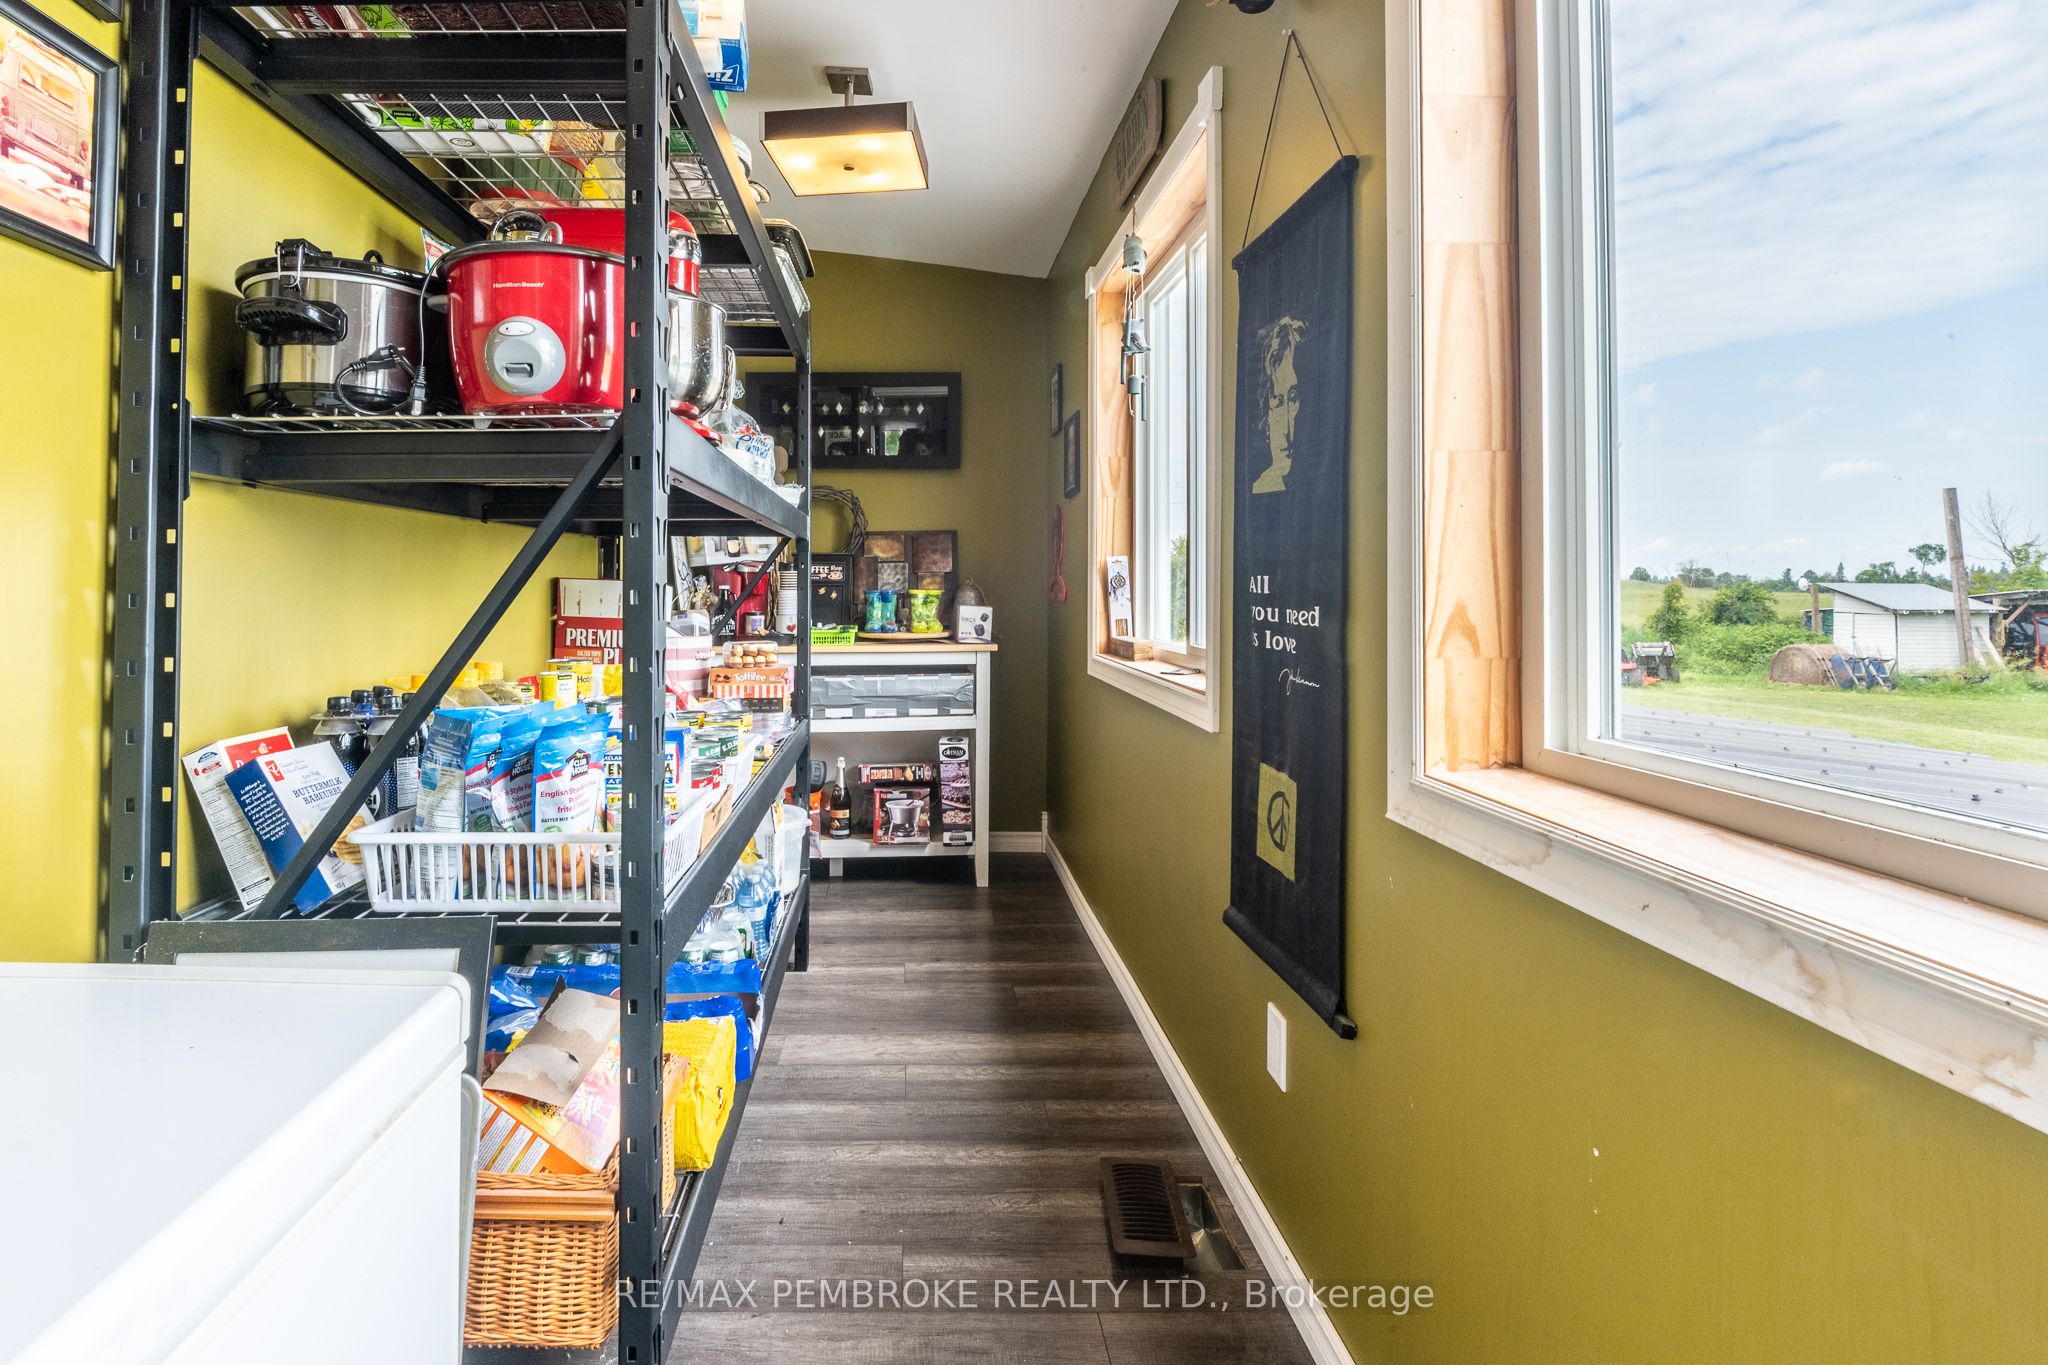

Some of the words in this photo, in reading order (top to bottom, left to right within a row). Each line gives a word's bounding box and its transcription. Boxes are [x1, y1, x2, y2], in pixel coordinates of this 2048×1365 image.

[810, 565, 830, 574] FFEE
[1249, 575, 1270, 594] All
[1286, 606, 1320, 627] need
[1252, 632, 1259, 647] s
[1265, 630, 1297, 654] love
[734, 671, 767, 682] Toffifee
[811, 761, 822, 783] YETI
[292, 776, 342, 798] BUTTERMILK
[540, 787, 569, 799] English
